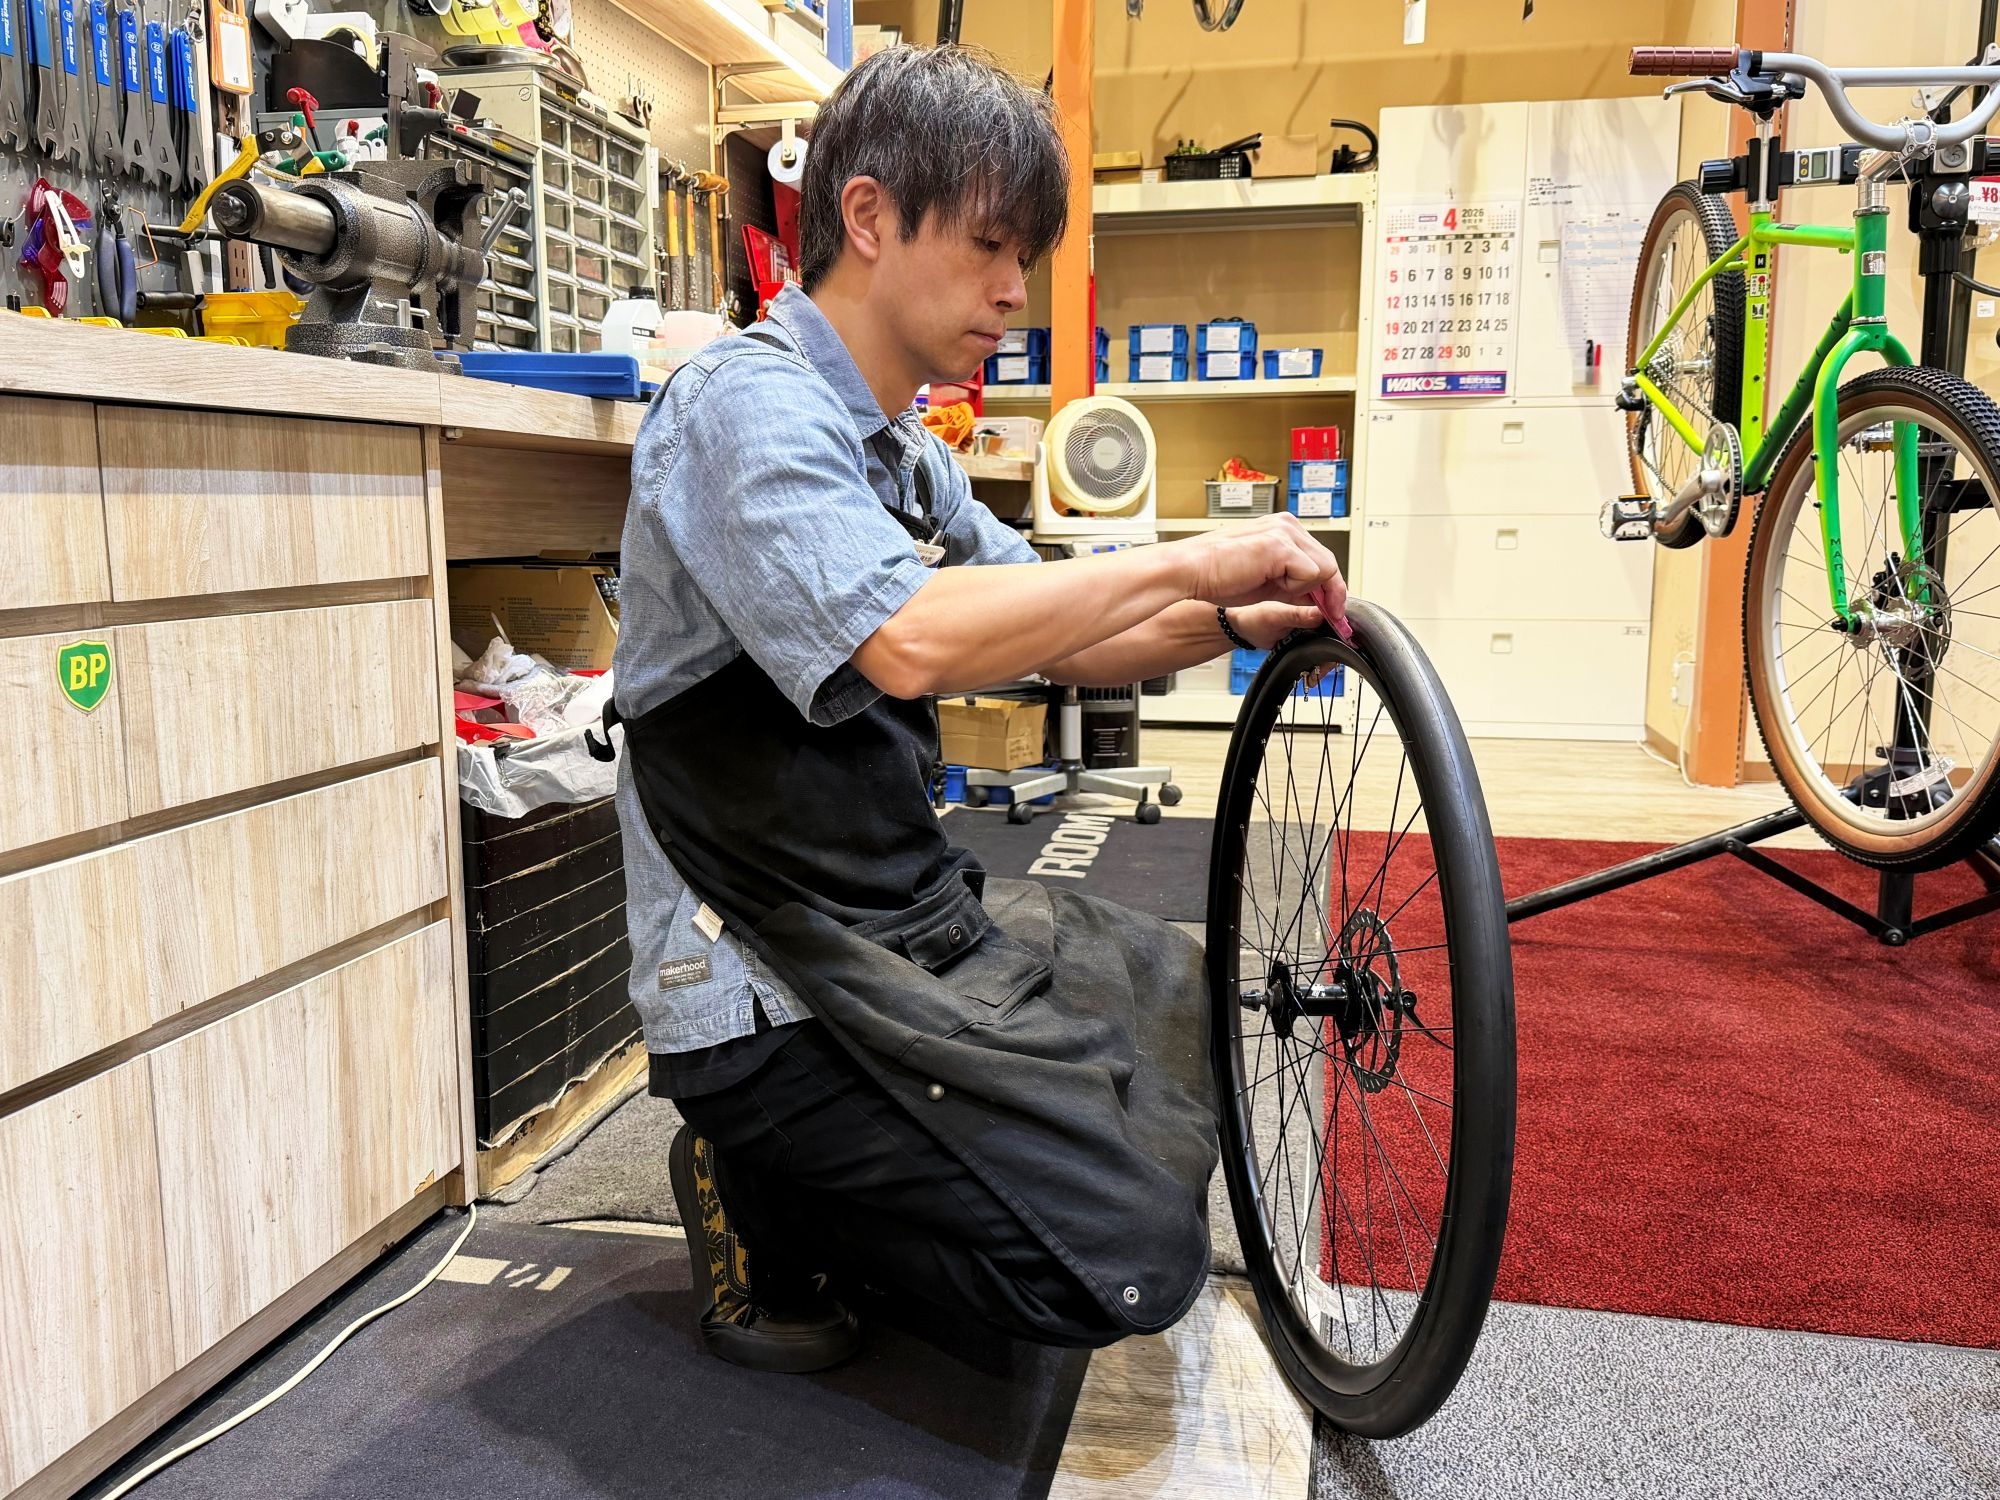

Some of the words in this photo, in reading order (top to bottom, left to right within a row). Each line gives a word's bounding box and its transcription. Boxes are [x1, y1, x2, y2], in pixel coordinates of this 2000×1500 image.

[1982, 187, 2000, 203] ¥8
[1443, 208, 1457, 230] 4
[1462, 208, 1484, 218] 2026
[1446, 242, 1452, 254] 1
[1464, 241, 1472, 254] 2
[1482, 240, 1490, 252] 3
[1501, 240, 1509, 252] 4
[1390, 270, 1398, 283] 5
[1408, 270, 1416, 282] 6
[1426, 269, 1434, 281] 7
[1444, 268, 1453, 280] 8
[1463, 268, 1472, 280] 9
[1479, 266, 1492, 279] 10
[1498, 266, 1510, 278] 11
[1387, 296, 1400, 309] 12
[1405, 296, 1418, 308] 13
[1423, 295, 1436, 307] 14
[1441, 294, 1454, 306] 15
[1460, 294, 1473, 306] 16
[1478, 293, 1491, 306] 17
[1496, 293, 1510, 305] 18
[1386, 322, 1399, 335] 19
[1403, 322, 1417, 334] 20
[1422, 321, 1434, 333] 21
[1439, 320, 1454, 332] 22
[1458, 320, 1472, 332] 23
[1476, 320, 1490, 332] 24
[1494, 319, 1508, 332] 25
[1384, 348, 1398, 361] 26
[1402, 348, 1416, 360] 27
[1420, 346, 1434, 360] 28
[1438, 346, 1453, 358] 29
[1456, 346, 1470, 358] 30
[1830, 537, 1846, 596] MARIN
[70, 653, 106, 690] BP
[1027, 812, 1115, 878] ROOM
[659, 959, 706, 977] makerhood
